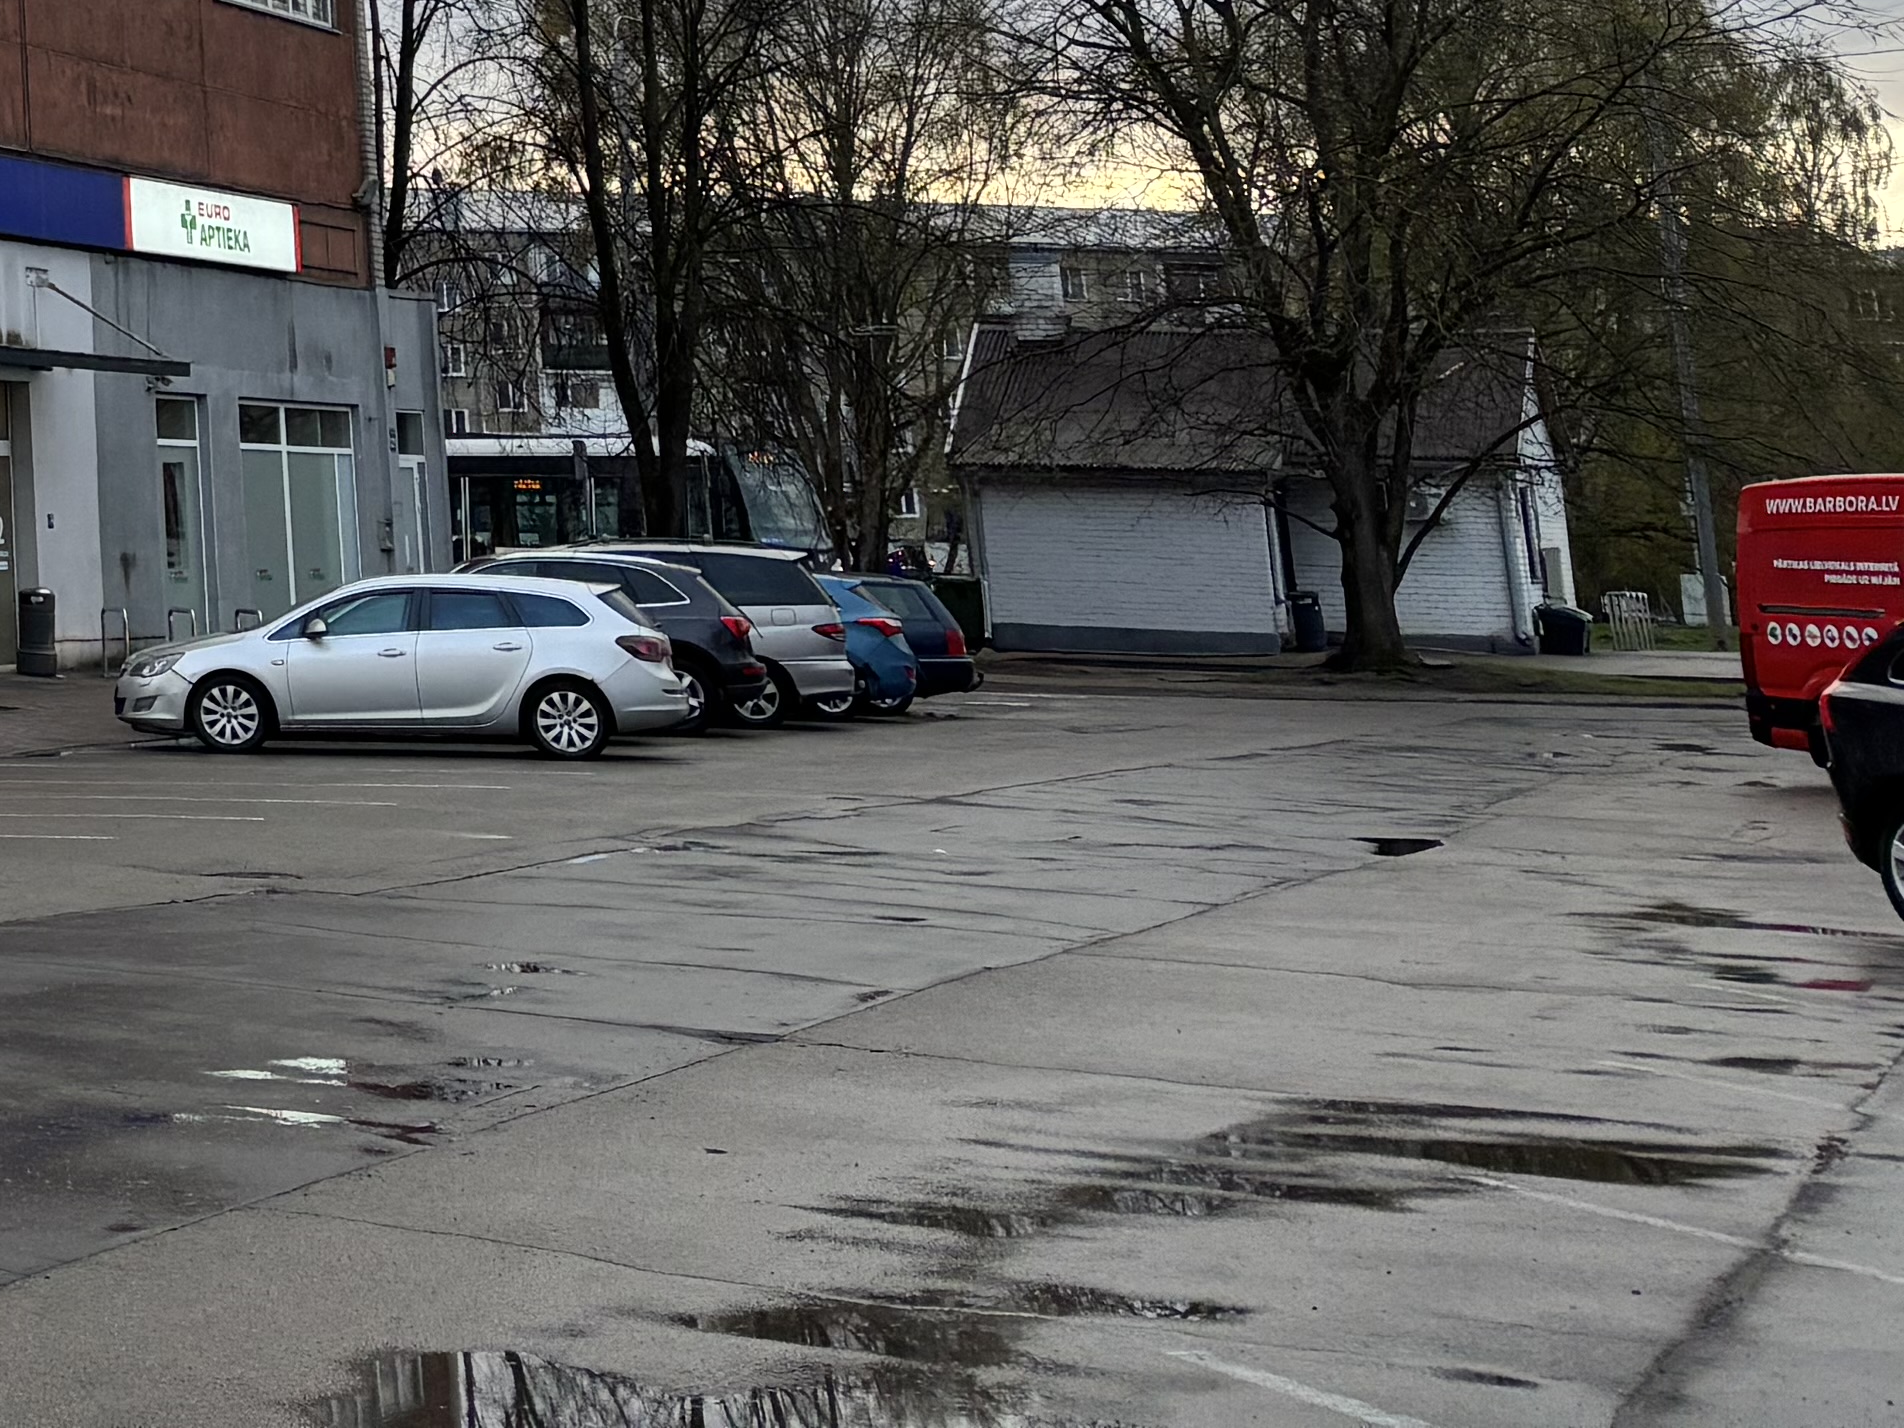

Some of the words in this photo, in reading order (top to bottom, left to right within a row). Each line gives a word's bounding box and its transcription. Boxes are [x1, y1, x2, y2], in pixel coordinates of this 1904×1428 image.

[198, 201, 230, 221] EURO
[200, 224, 250, 253] APTIEKA
[1766, 496, 1899, 514] WWW.BARBORA.LV
